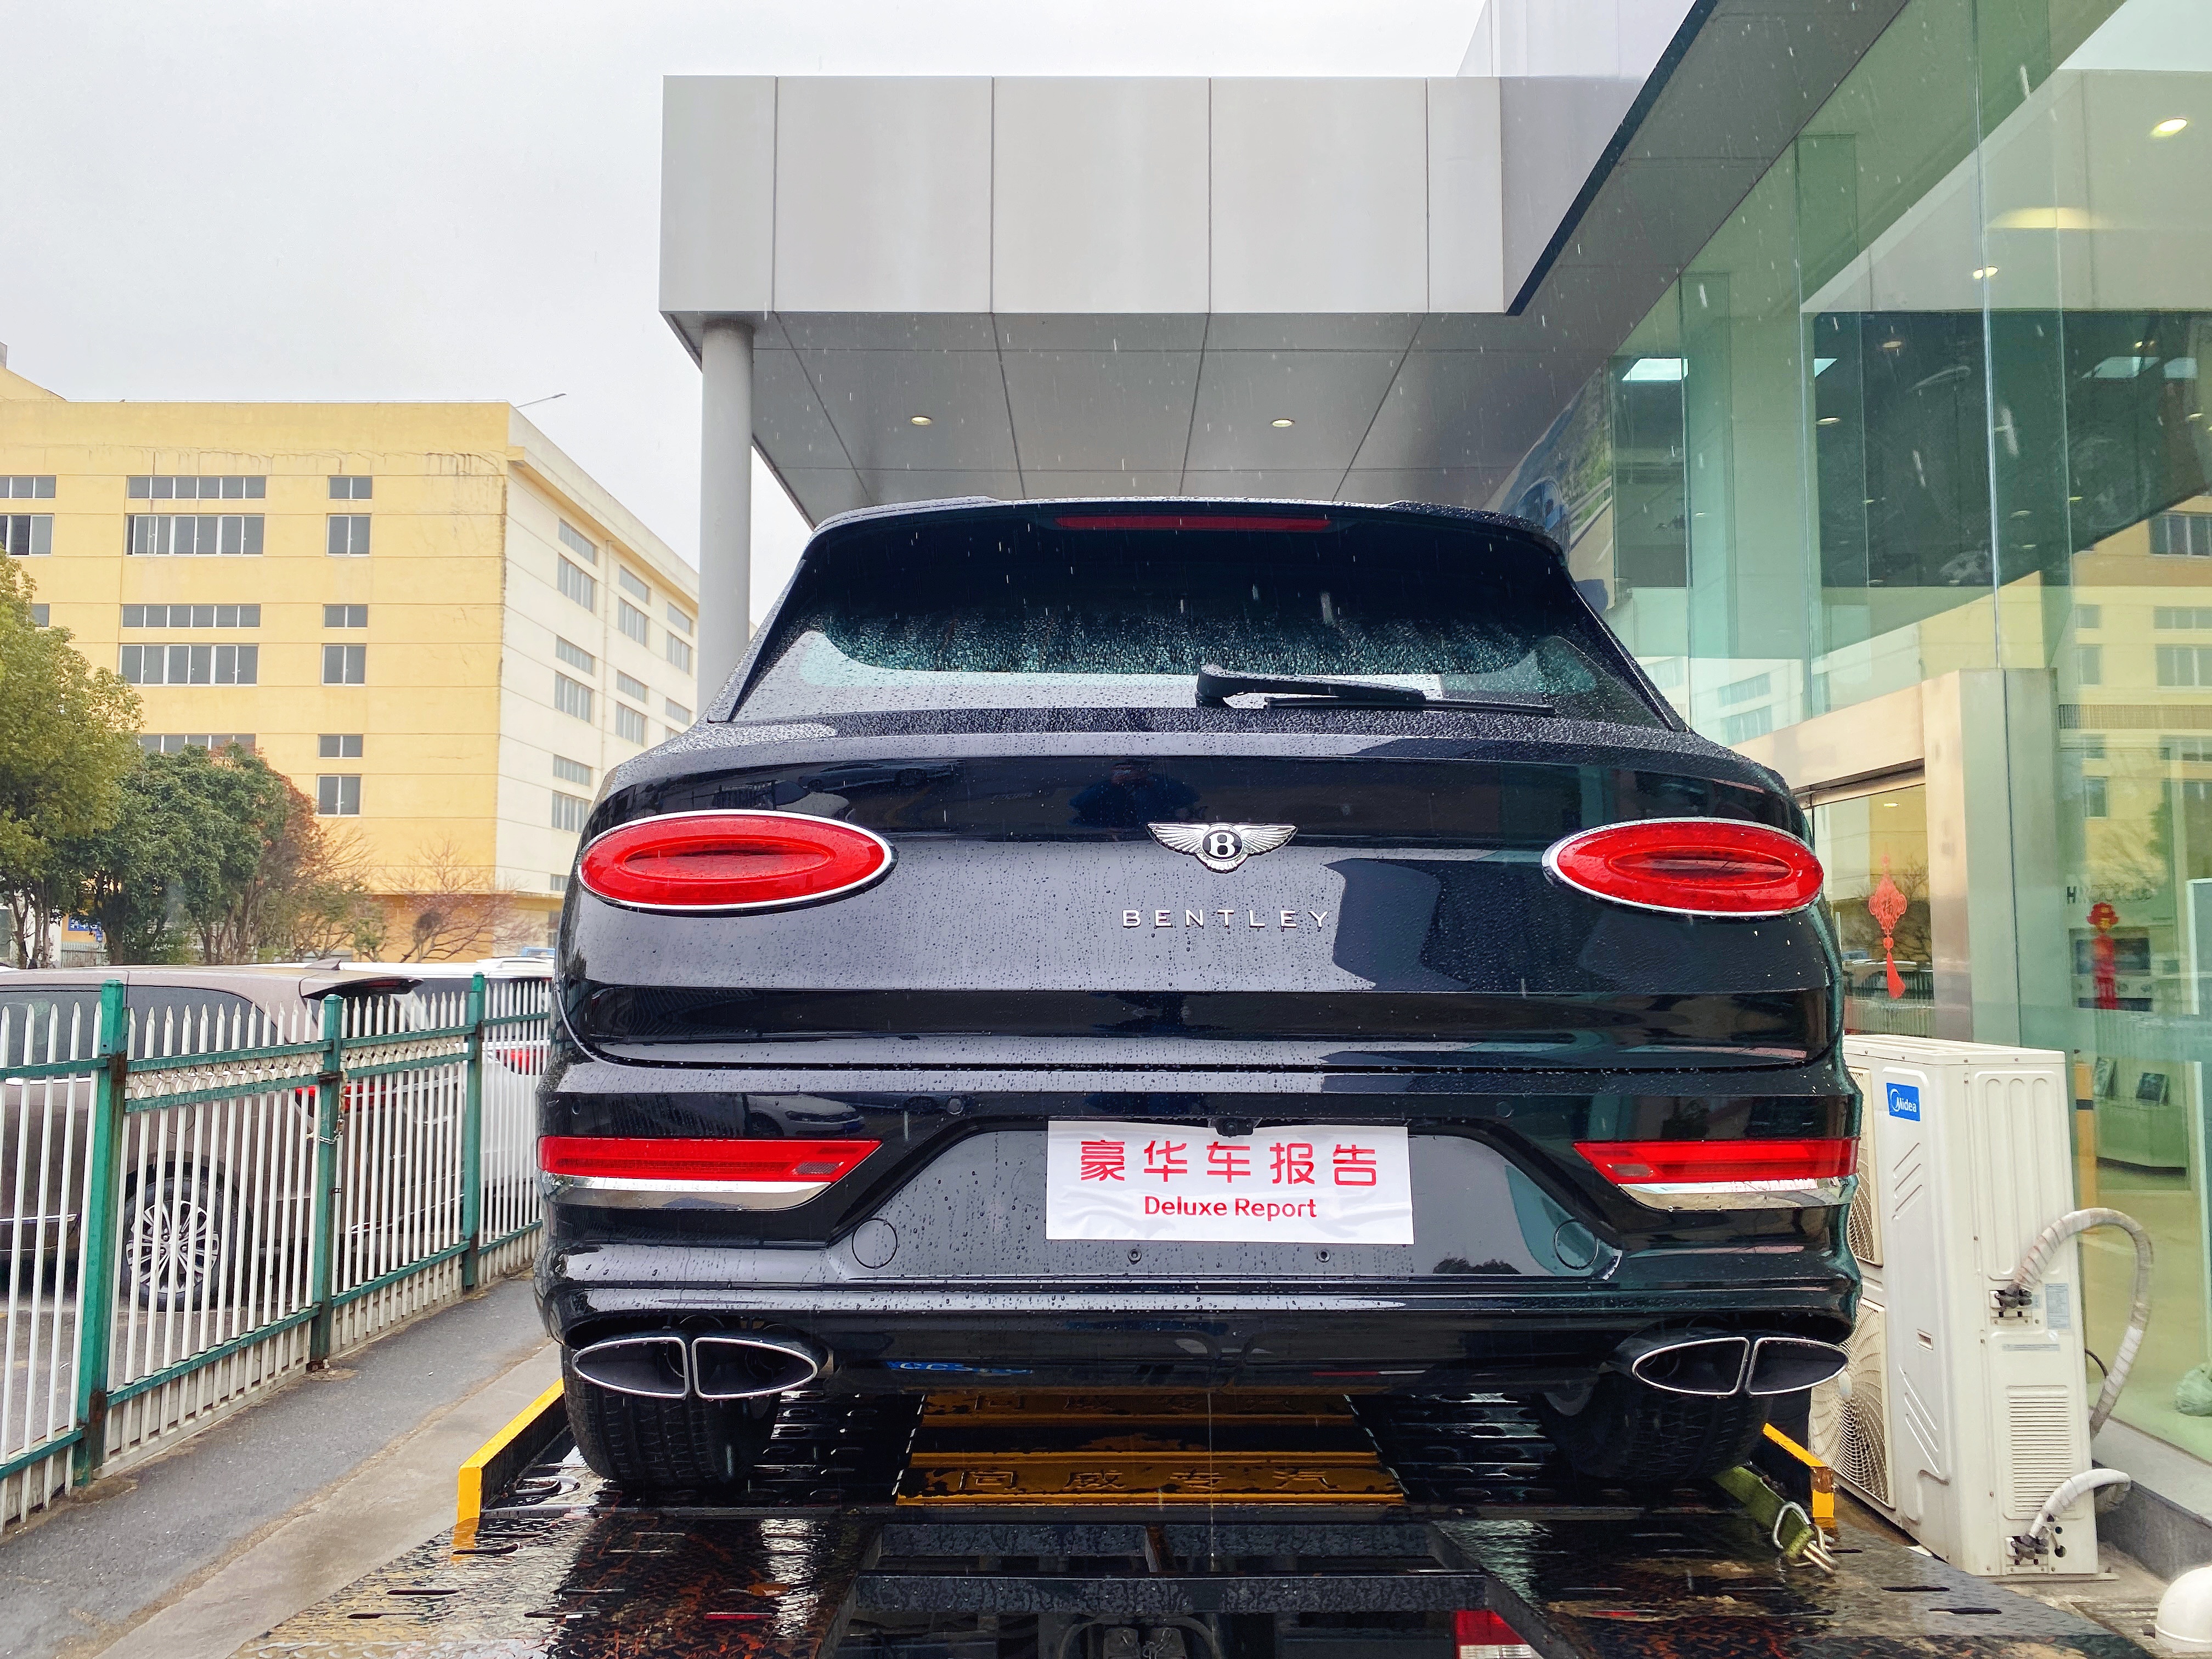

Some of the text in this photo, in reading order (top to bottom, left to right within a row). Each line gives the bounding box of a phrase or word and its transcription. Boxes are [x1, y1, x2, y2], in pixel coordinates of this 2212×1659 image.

[1209, 834, 1235, 857] B
[1122, 909, 1328, 928] BENTLEY
[1890, 1088, 1917, 1113] Midea
[1081, 1140, 1376, 1186] 豪华车报告
[1145, 1196, 1317, 1221] Deluxe Report
